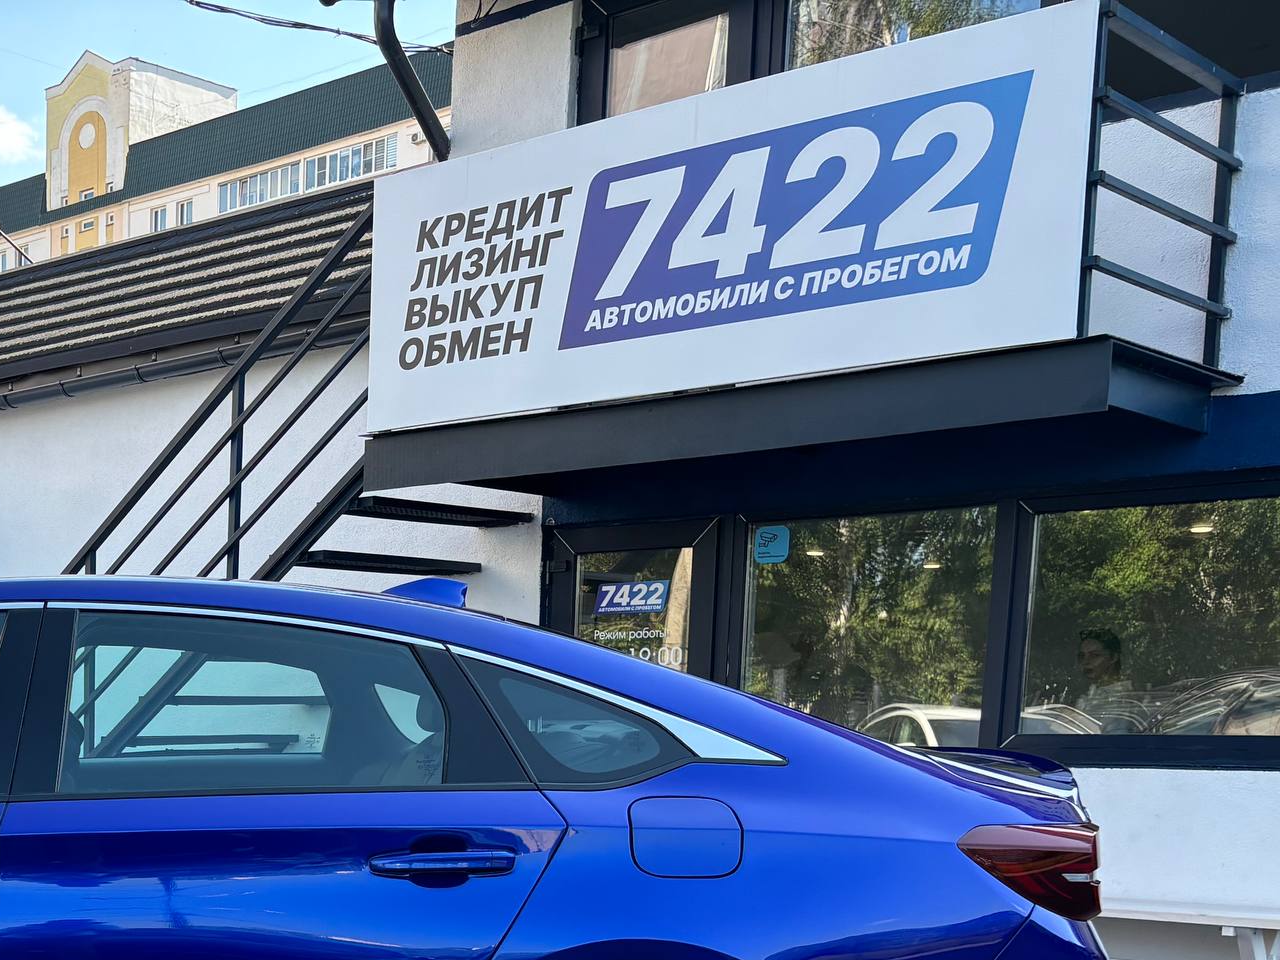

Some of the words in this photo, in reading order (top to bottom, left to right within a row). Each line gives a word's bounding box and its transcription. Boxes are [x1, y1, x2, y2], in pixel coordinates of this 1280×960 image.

[416, 186, 573, 253] КРЕДИТ
[594, 101, 994, 300] 7422
[410, 229, 564, 292] ЛИЗИНГ
[584, 280, 770, 332] АВТОМОБИЛИ
[773, 276, 795, 300] С
[799, 244, 972, 297] ПРОБЕГОМ
[404, 274, 544, 331] ВЫКУП
[399, 317, 533, 370] ОБМЕН
[600, 582, 664, 607] 7422
[594, 629, 626, 640] Режим
[628, 627, 666, 641] работы
